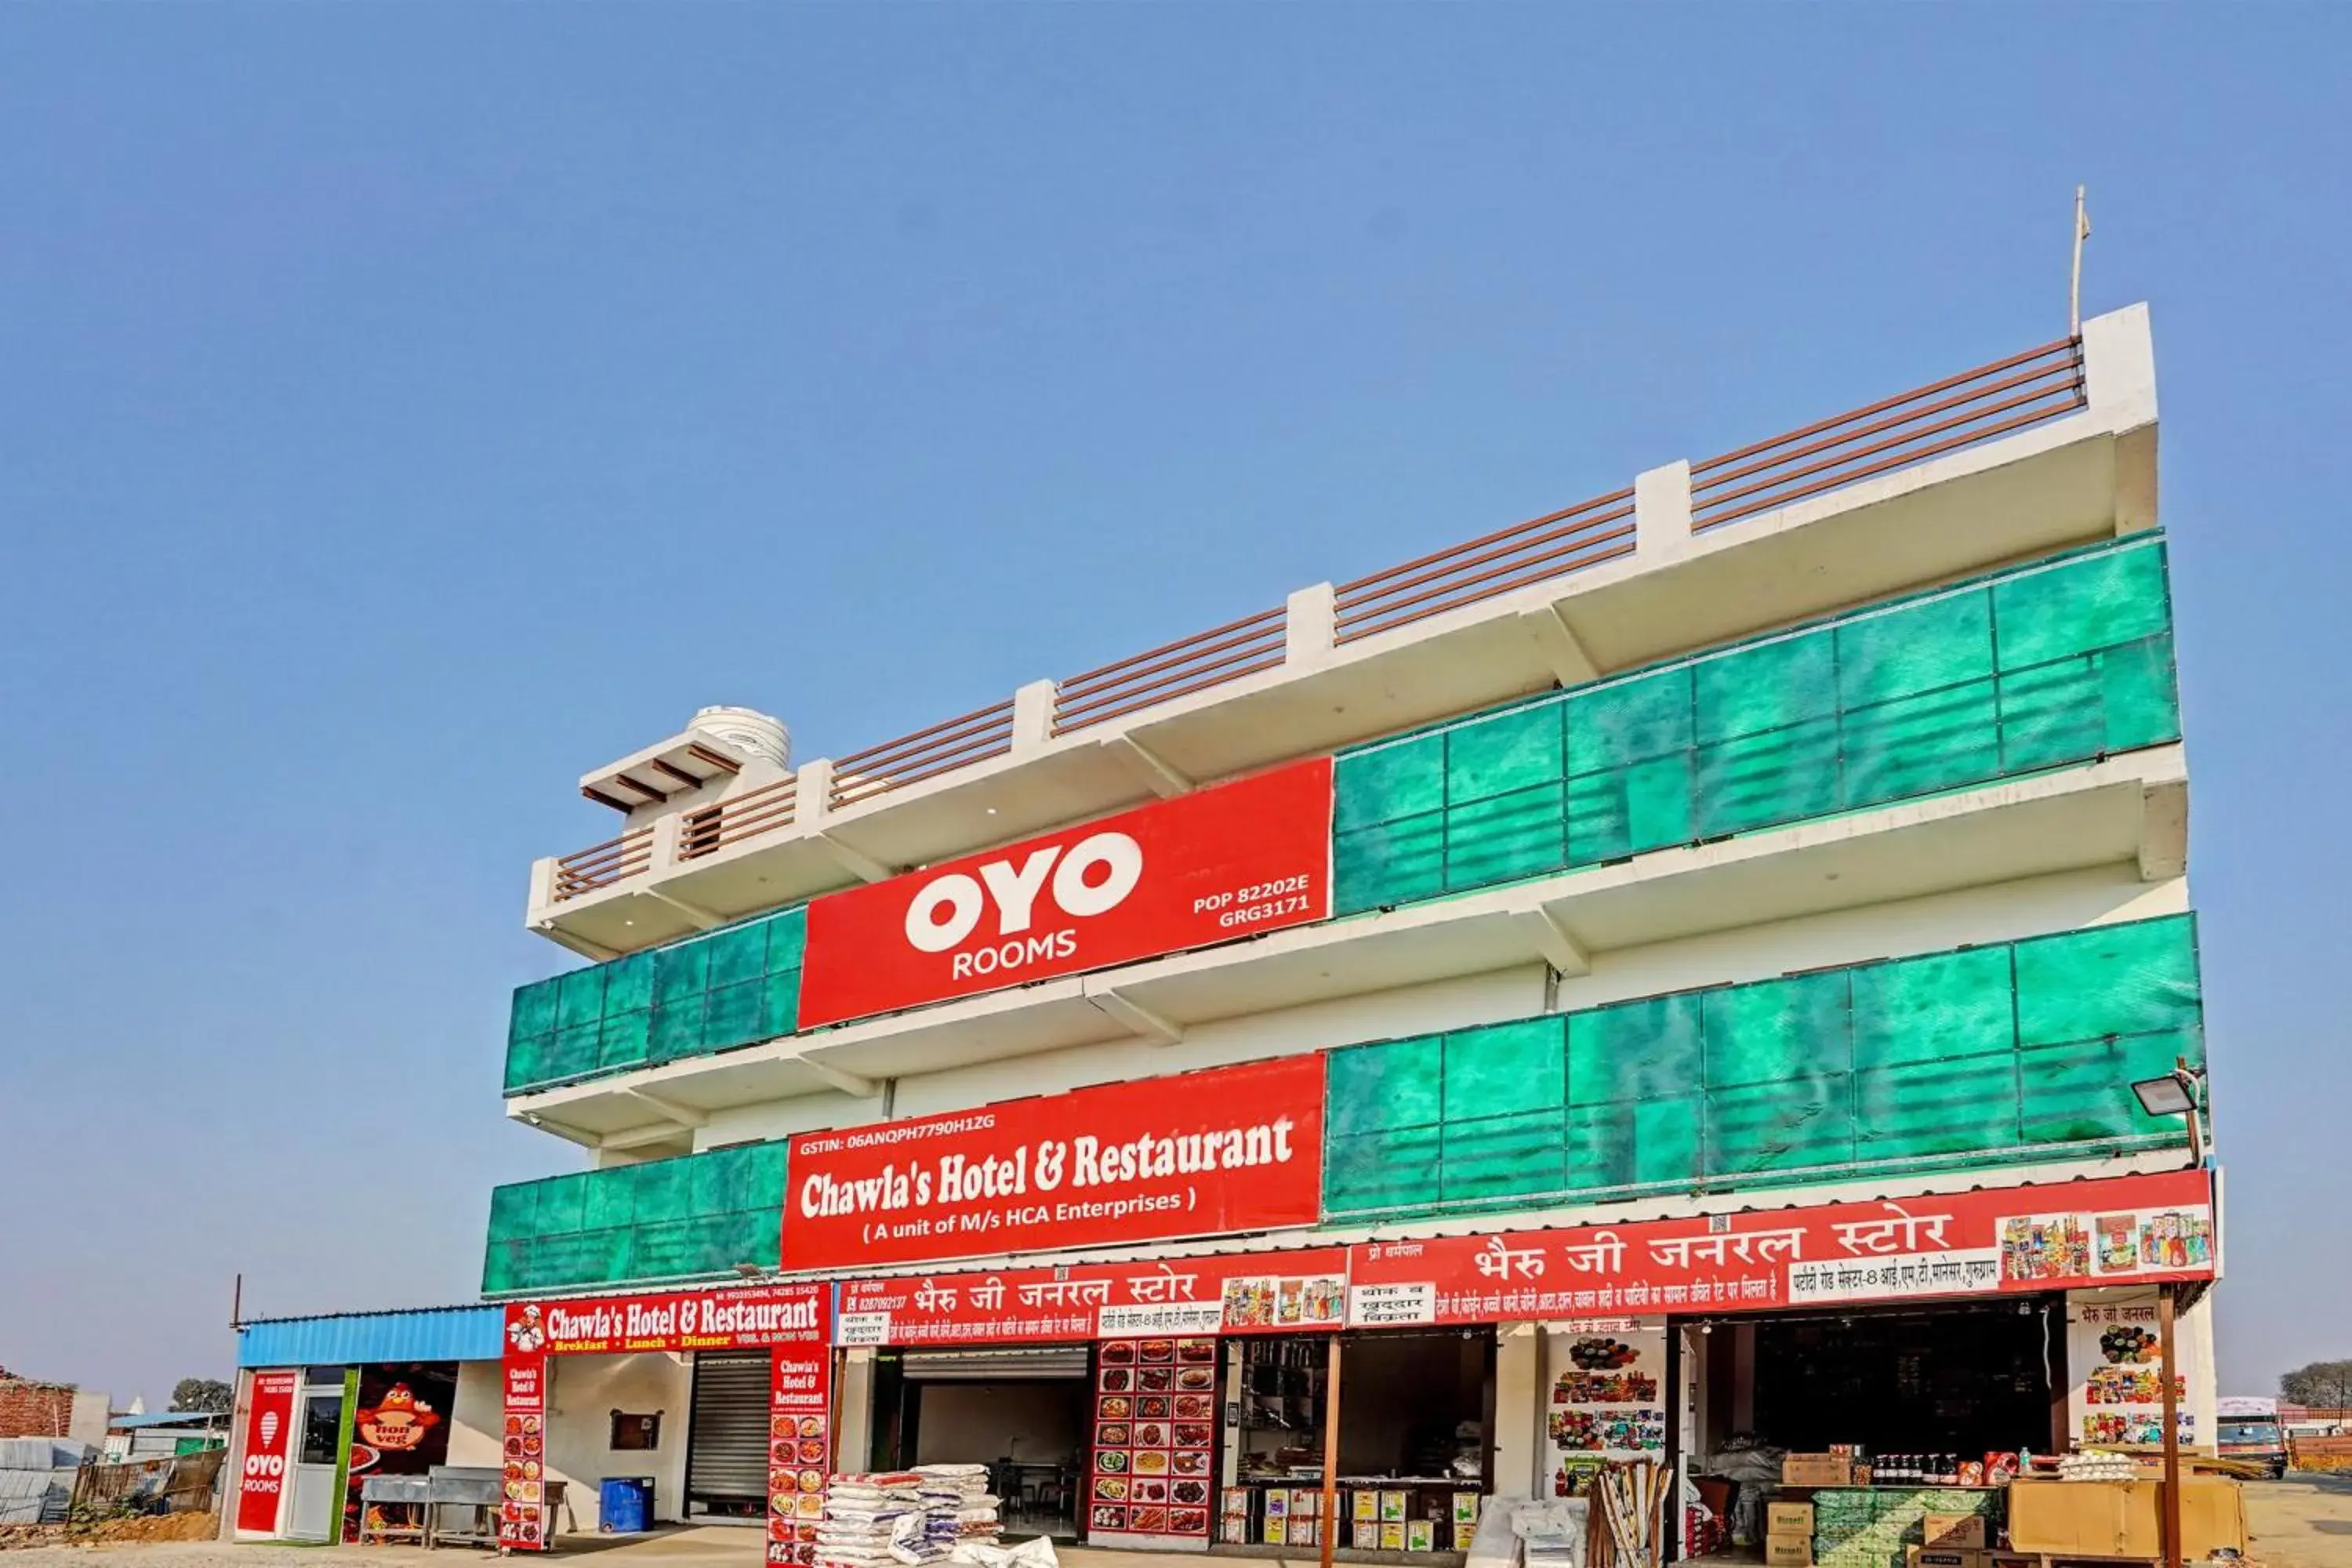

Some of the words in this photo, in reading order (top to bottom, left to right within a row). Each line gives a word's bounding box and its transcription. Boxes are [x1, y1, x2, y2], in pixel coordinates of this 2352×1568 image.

[904, 831, 1144, 953] OYO
[1193, 892, 1232, 914] POP
[1237, 874, 1309, 903] 82202E
[1219, 895, 1309, 927] GRG3171
[951, 928, 1077, 980] ROOMS
[800, 1137, 844, 1155] GSTIN:
[800, 1160, 931, 1218] Chawla's
[938, 1143, 1025, 1202] Hotel
[1034, 1140, 1065, 1190] &
[1072, 1114, 1294, 1187] Restaurant
[892, 1220, 930, 1238] unit
[935, 1215, 955, 1233] of
[960, 1213, 1000, 1233] M/s
[1006, 1207, 1049, 1225] HCA
[1056, 1193, 1181, 1221] Enterprises
[1474, 1236, 1547, 1280] भैरु
[1566, 1229, 1628, 1274] जी
[1647, 1228, 1808, 1268] जनरल
[1831, 1203, 1954, 1254] स्टोर
[914, 1278, 957, 1313] भैरु
[969, 1276, 1006, 1311] जी
[1017, 1279, 1112, 1306] जनरल
[1127, 1263, 1198, 1302] स्टोर
[548, 1308, 622, 1339] Chawla's
[627, 1302, 676, 1336] Hotel
[680, 1299, 697, 1334] &
[701, 1295, 818, 1333] Restaurant
[555, 1340, 608, 1350] Brekfast
[626, 1338, 666, 1348] Lunch
[681, 1335, 731, 1346] Dinner
[781, 1360, 819, 1374] Chawla's
[783, 1374, 807, 1388] Hotel
[775, 1392, 823, 1404] Restaurant
[246, 1455, 283, 1475] OYO
[244, 1479, 278, 1492] ROOMS
